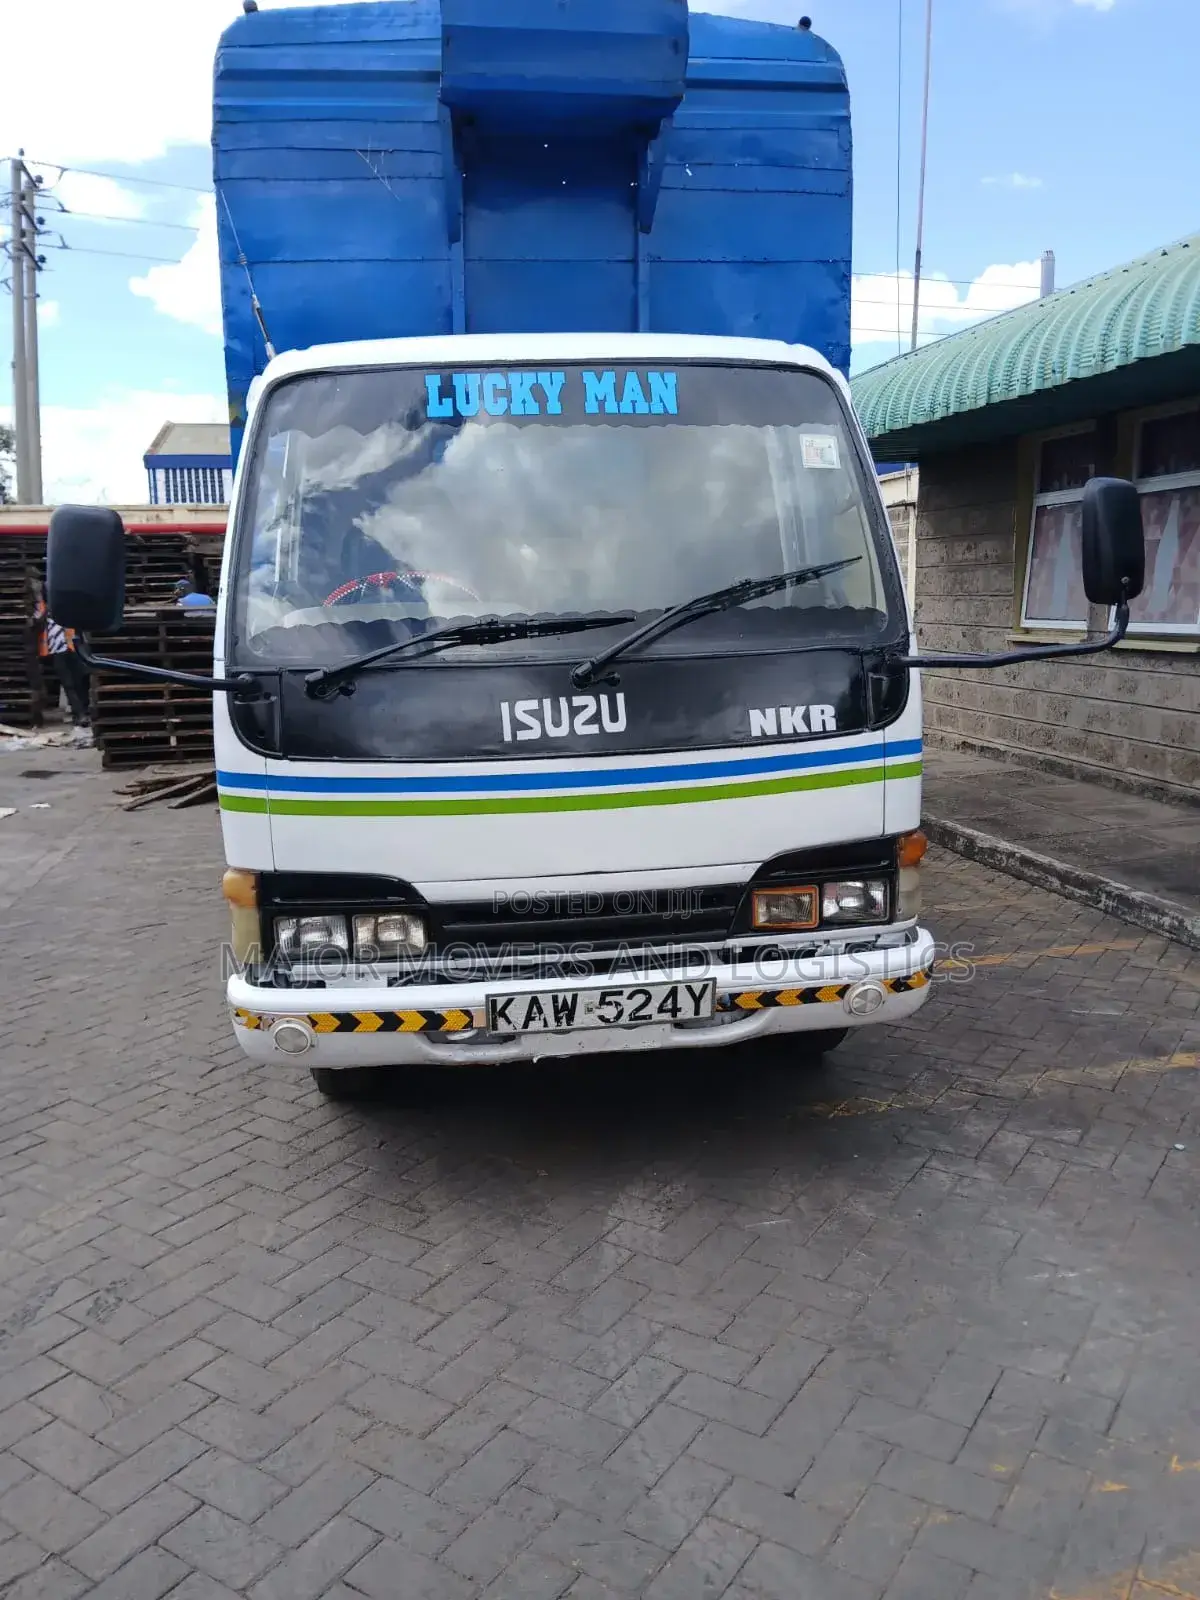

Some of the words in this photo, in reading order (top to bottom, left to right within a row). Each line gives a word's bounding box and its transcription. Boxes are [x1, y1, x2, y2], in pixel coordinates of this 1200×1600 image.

[424, 371, 566, 418] LUCKY
[581, 370, 678, 416] MAN
[500, 692, 627, 743] ISUZU
[749, 704, 837, 737] NKR
[490, 993, 578, 1032] KAW
[598, 983, 709, 1024] 524Y
